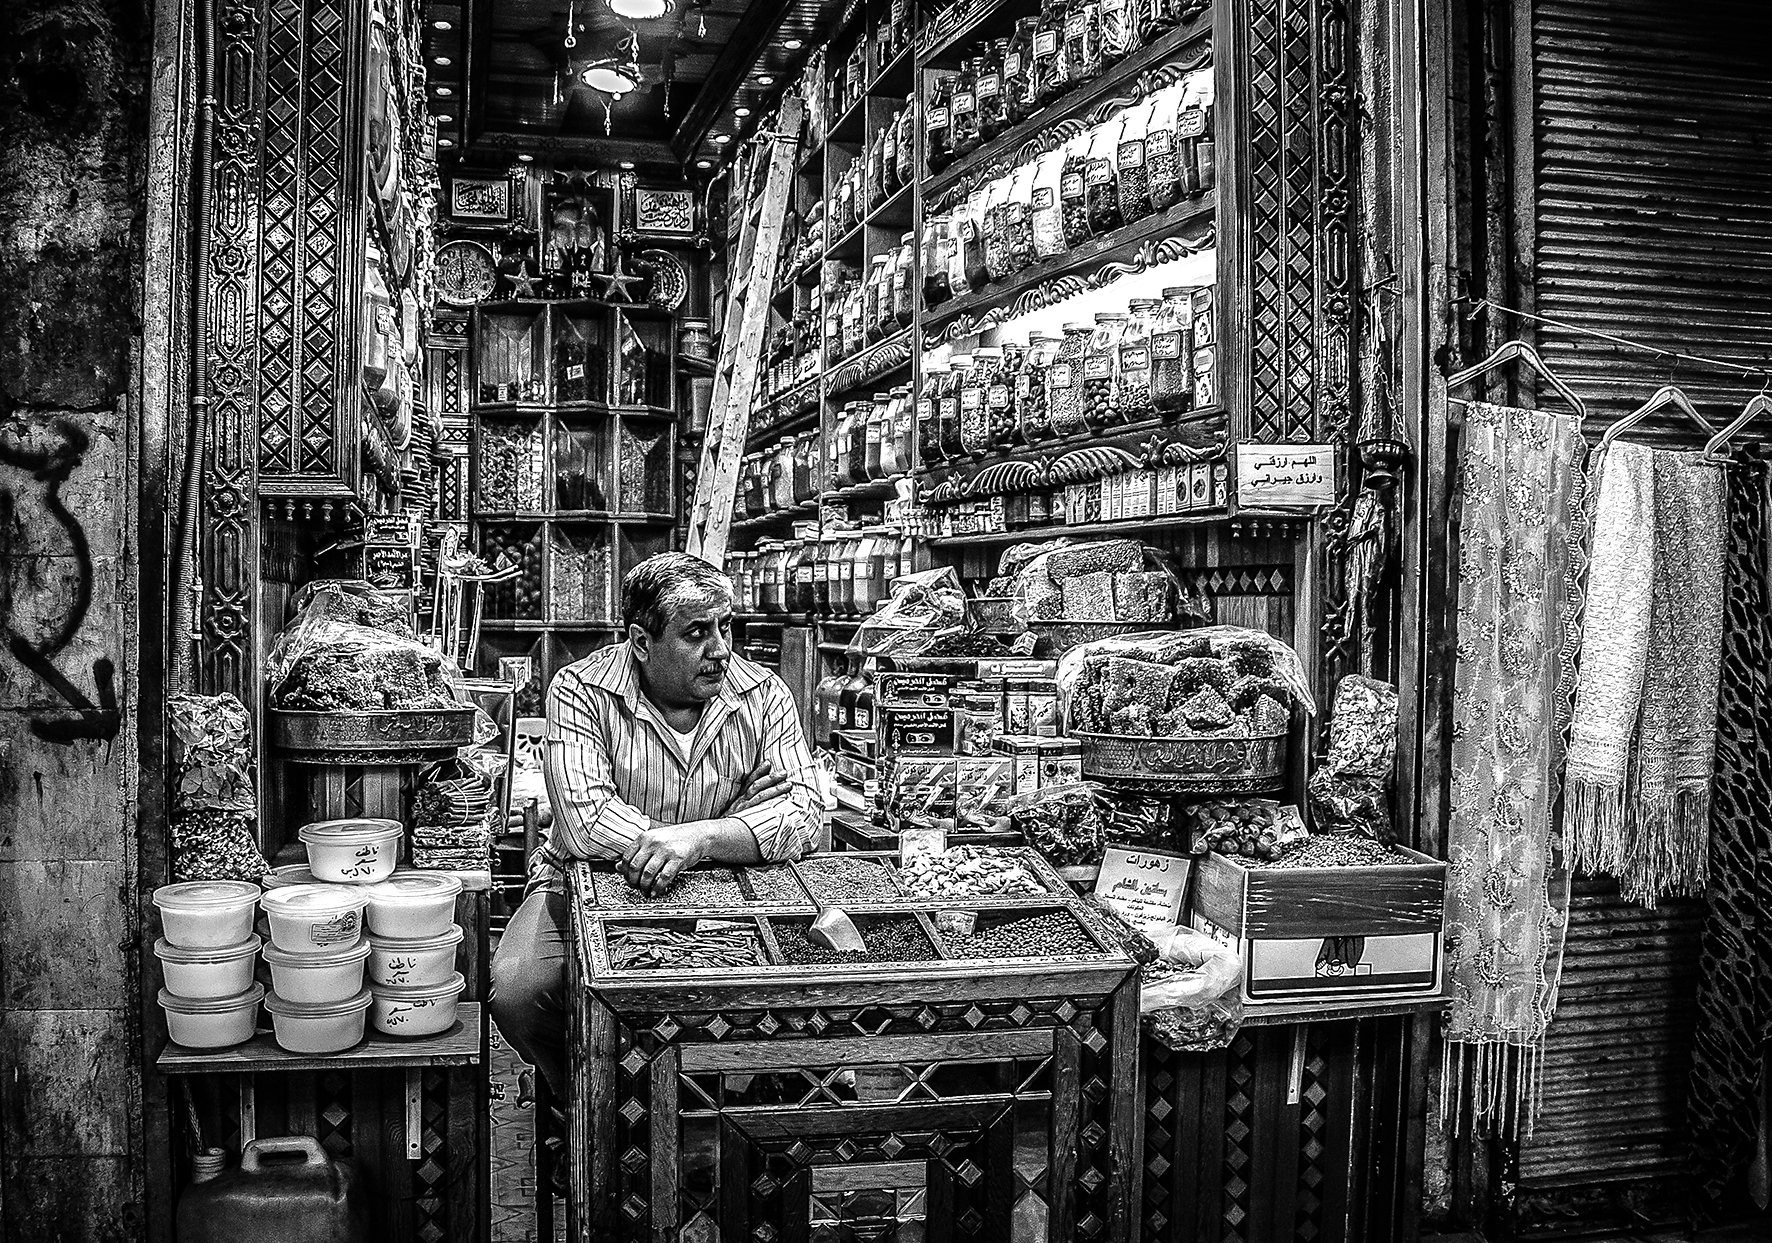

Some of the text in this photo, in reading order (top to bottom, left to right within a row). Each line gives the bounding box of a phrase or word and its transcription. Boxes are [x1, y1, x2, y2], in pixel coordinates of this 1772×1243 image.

[1291, 455, 1317, 469] اللهم
[1250, 472, 1323, 487] وارزق جيراني
[1125, 854, 1170, 872] زهورات
